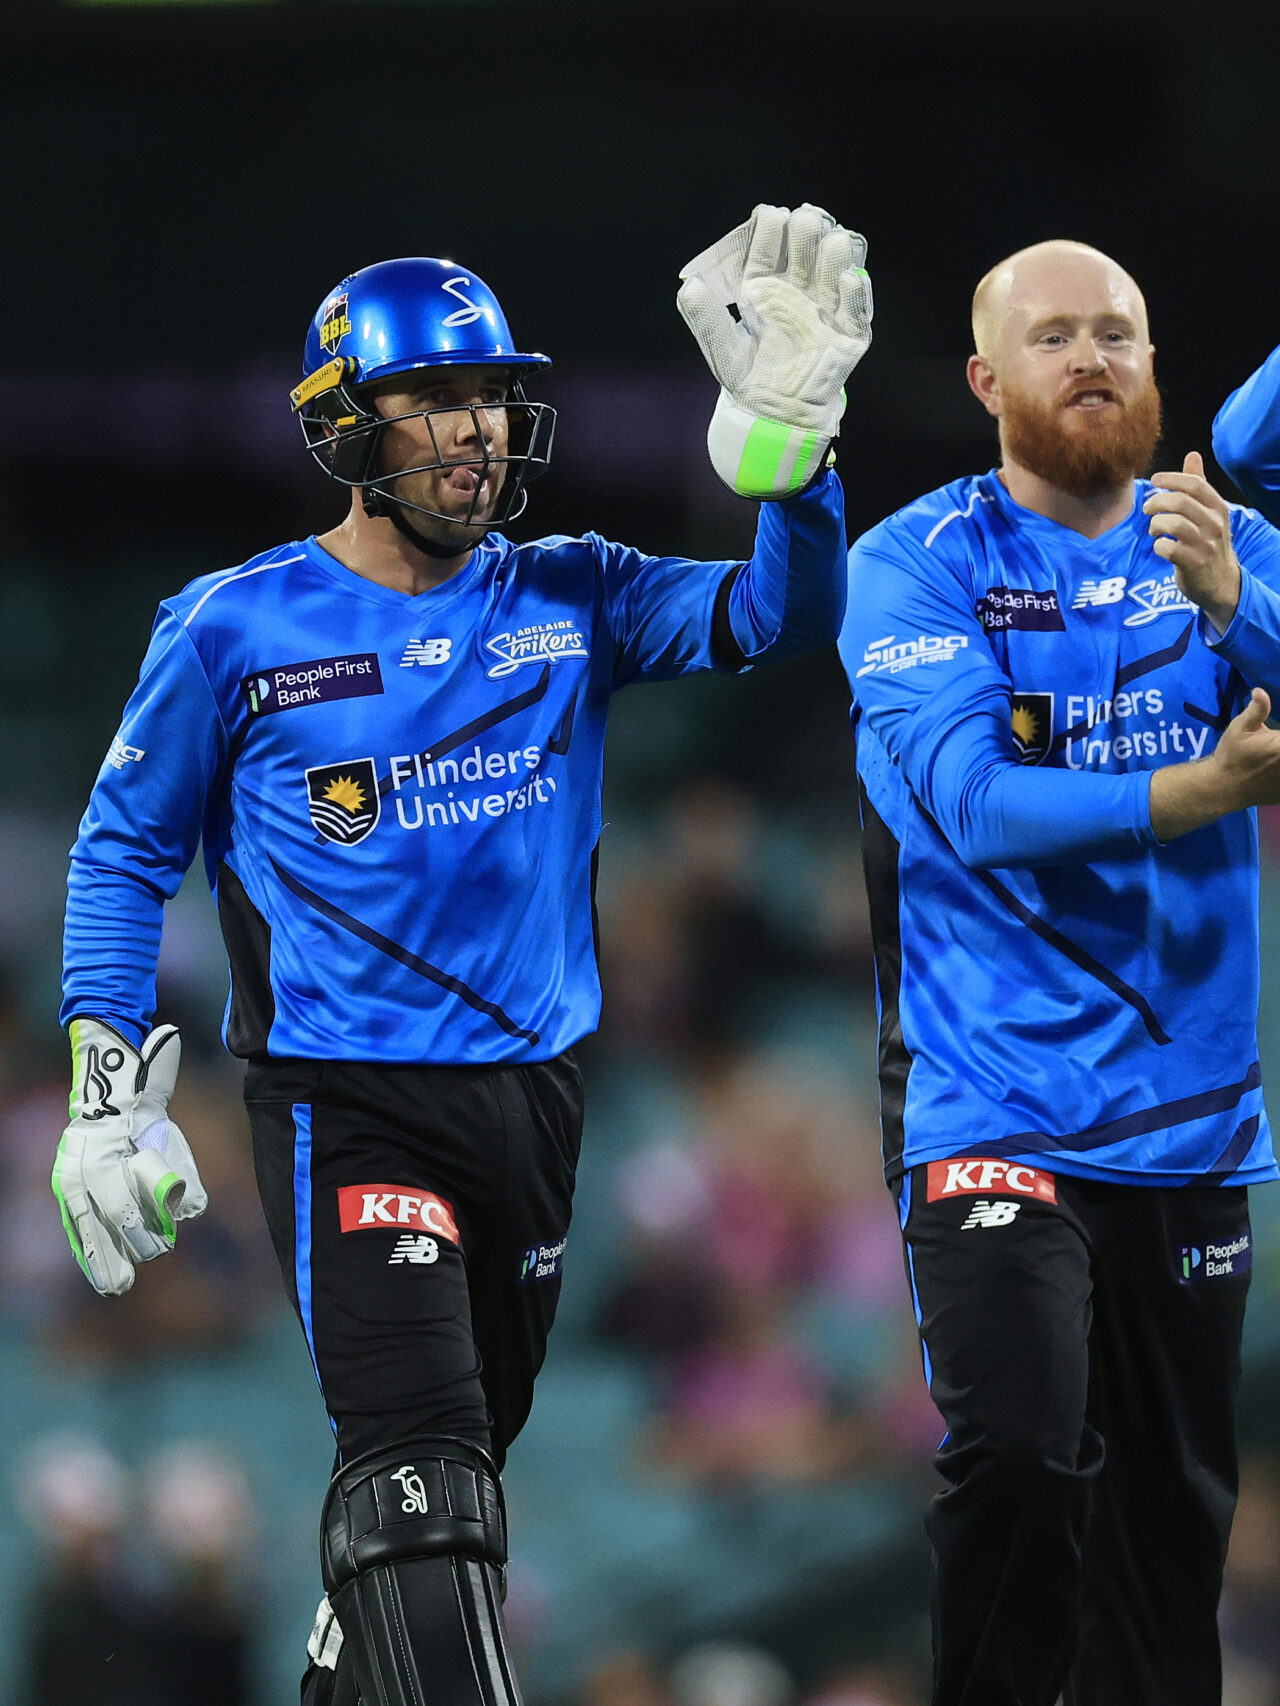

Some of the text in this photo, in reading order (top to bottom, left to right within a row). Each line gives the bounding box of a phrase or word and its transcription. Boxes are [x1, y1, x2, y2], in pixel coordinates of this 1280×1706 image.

[321, 315, 351, 345] BBL
[1024, 594, 1057, 611] First
[517, 620, 573, 637] ADELAIDE
[985, 611, 1012, 627] Bak
[485, 631, 588, 678] Strikers
[856, 635, 969, 678] Simba
[890, 652, 954, 674] CAR HIRE
[275, 660, 372, 690] People First
[277, 684, 321, 706] Bank
[1067, 688, 1164, 729] Fliners
[1066, 720, 1209, 771] Unersity
[389, 745, 541, 790] Flinders
[942, 1161, 1037, 1194] KFC
[358, 1193, 443, 1231] KFC
[1206, 1241, 1239, 1260] People
[536, 1260, 556, 1277] Bank
[1206, 1259, 1233, 1276] Bank
